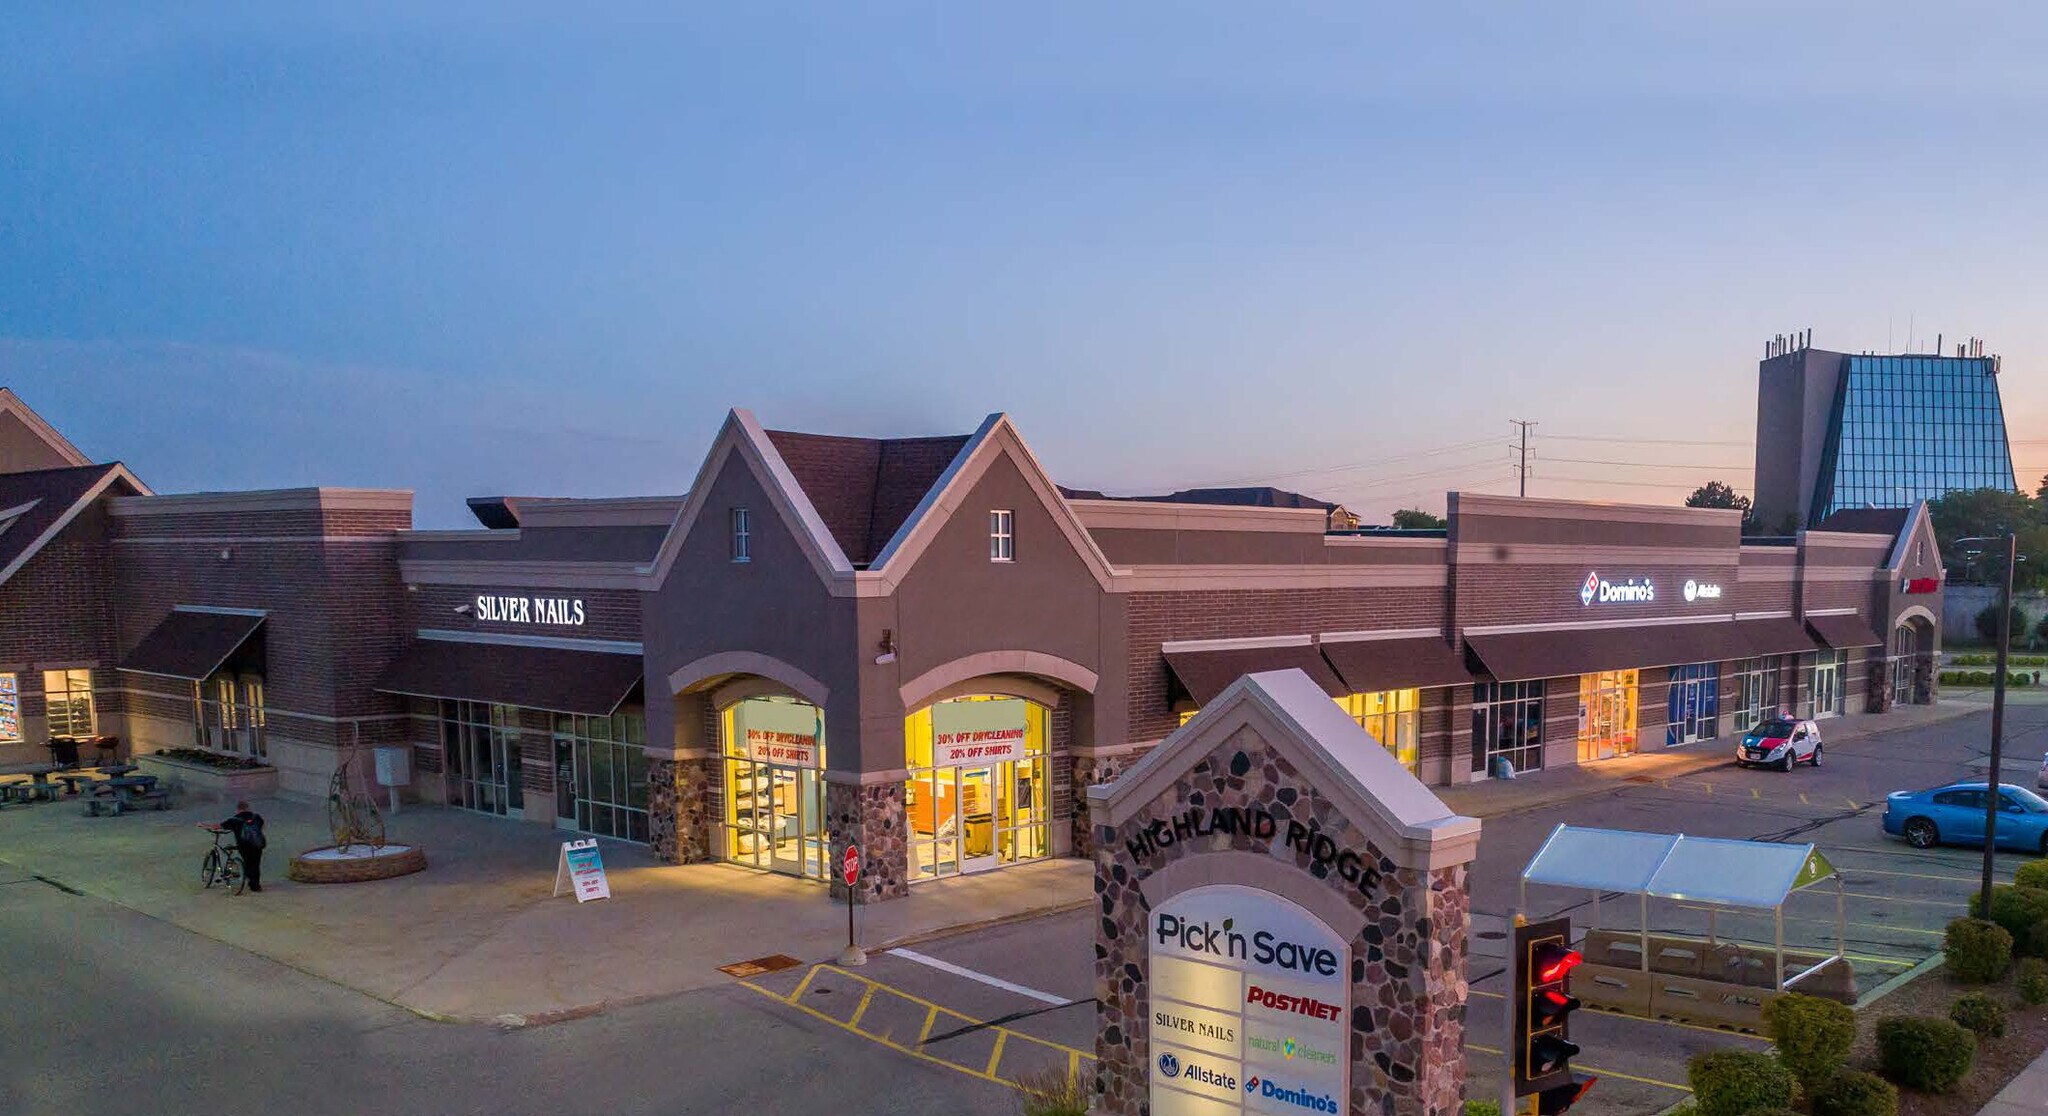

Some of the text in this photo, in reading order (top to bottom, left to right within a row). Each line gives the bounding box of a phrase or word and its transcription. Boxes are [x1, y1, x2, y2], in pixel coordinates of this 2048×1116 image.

[1600, 579, 1654, 601] Domino's
[477, 595, 585, 625] SILVER NAILS
[937, 729, 1023, 744] 30% OFF DRYCLEANING
[772, 747, 785, 758] OFF
[786, 749, 809, 761] SHIRTS
[950, 745, 1012, 759] 20% OFF SHIRTS
[845, 856, 858, 874] STOP
[1125, 807, 1382, 899] HIGHLAND RIDGE
[1253, 931, 1337, 976] Save
[1155, 1012, 1234, 1043] SILVER NAILS
[1248, 1036, 1280, 1052] natural
[1184, 1064, 1236, 1090] Allstate
[1262, 1079, 1337, 1114] Domino's
